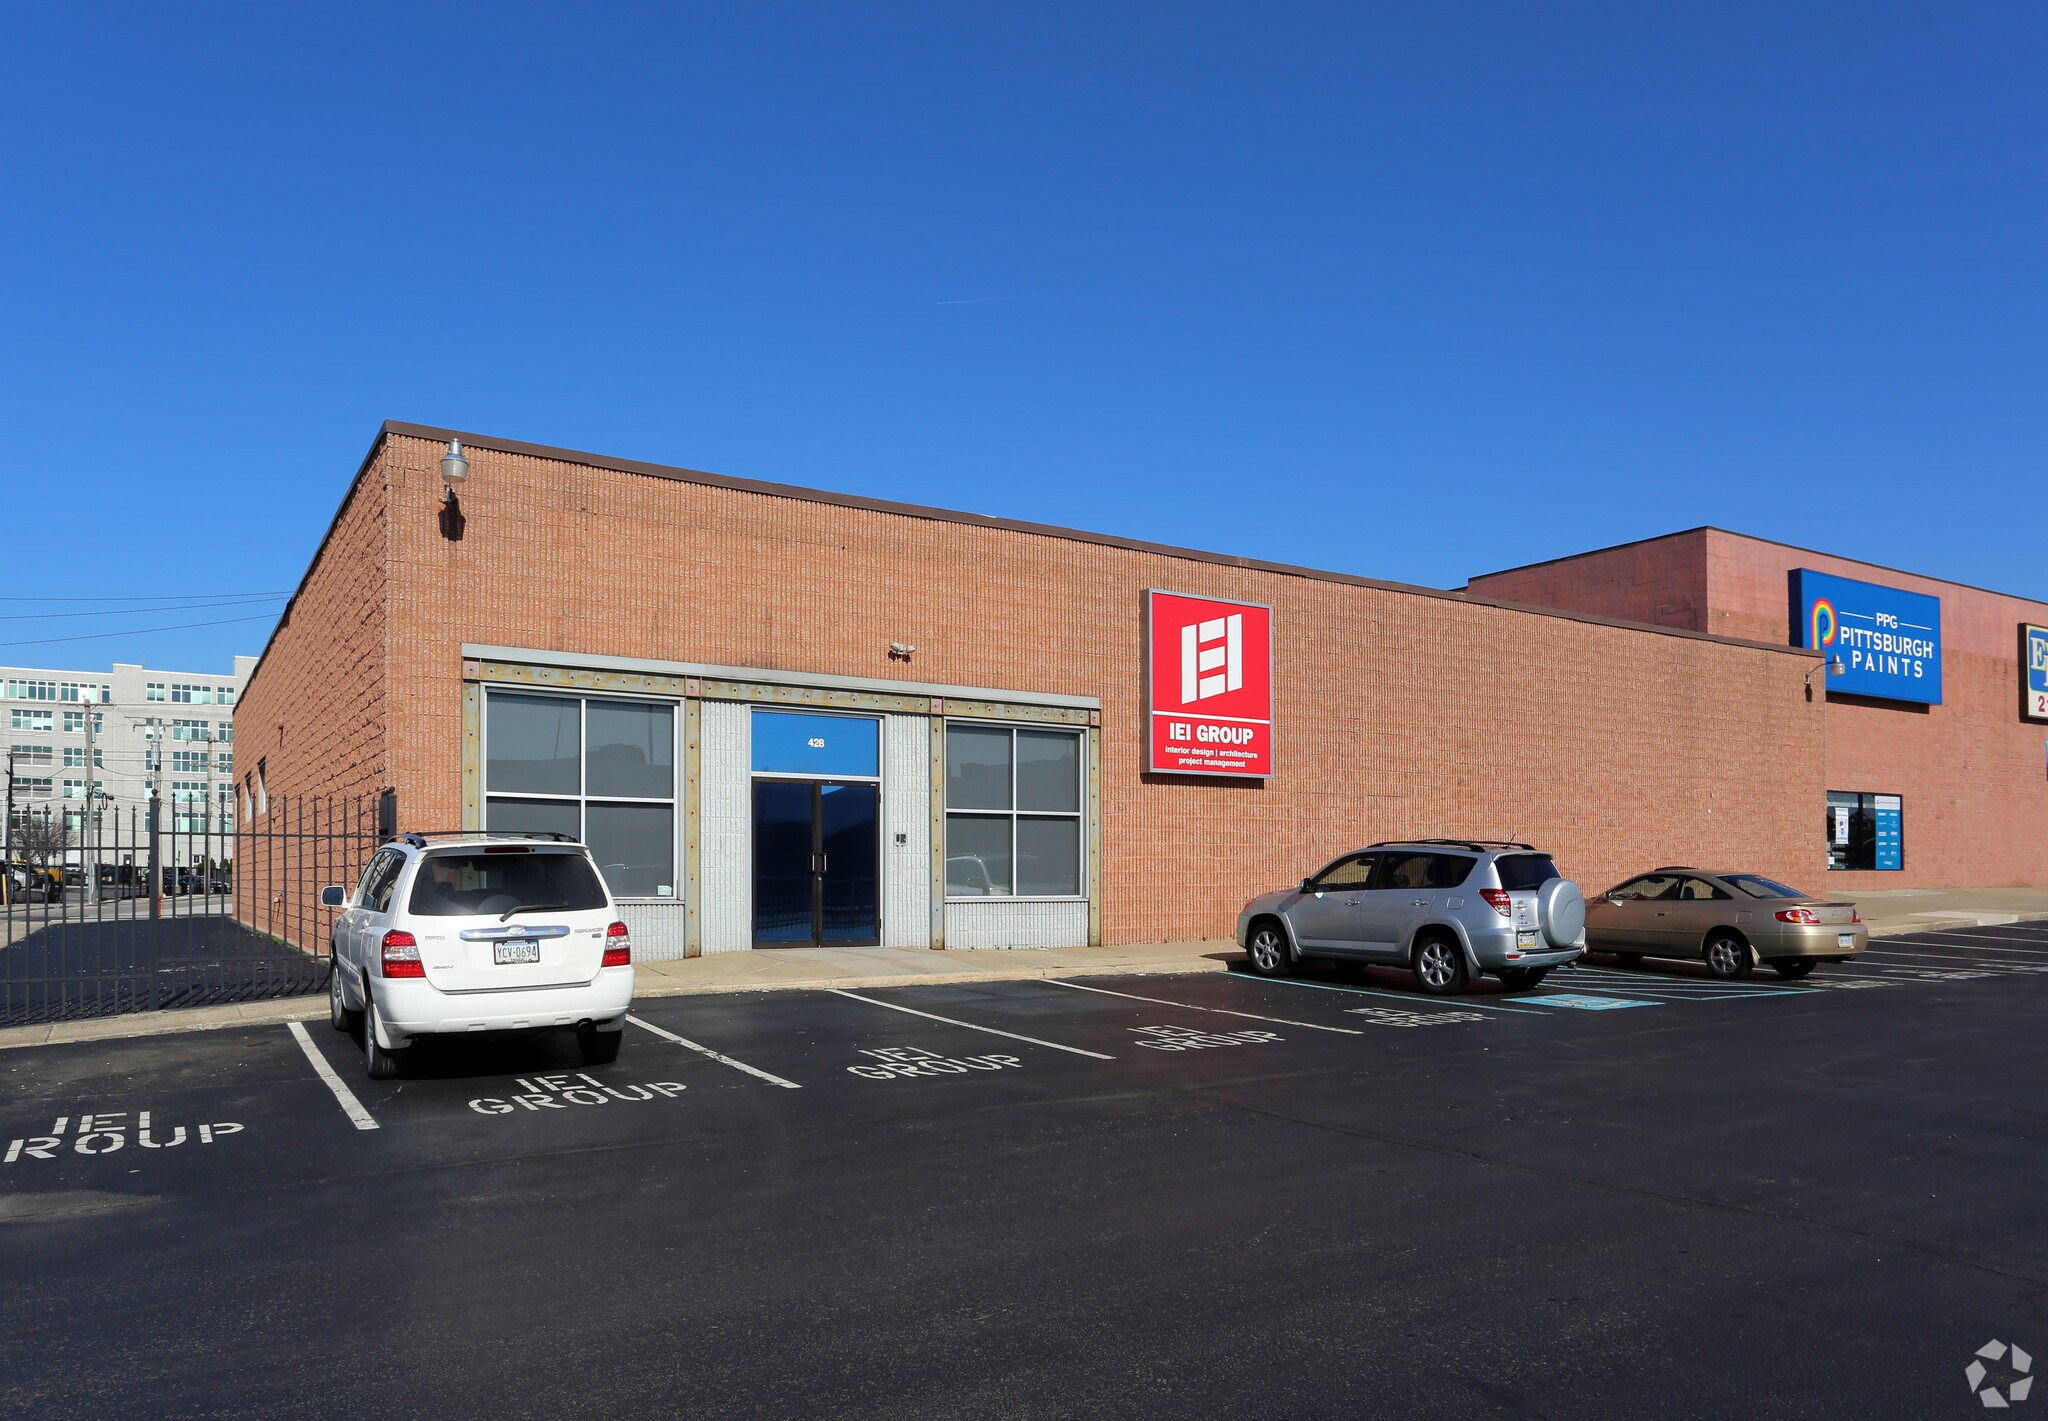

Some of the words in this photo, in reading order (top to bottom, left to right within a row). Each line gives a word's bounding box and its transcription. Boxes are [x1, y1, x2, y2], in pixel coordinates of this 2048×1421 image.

[1876, 612, 1898, 629] PPG
[1840, 626, 1933, 659] PITTSBURGH
[1852, 649, 1923, 679] PAINTS
[808, 737, 825, 748] 428
[1169, 722, 1191, 741] IEI
[1196, 724, 1254, 745] GROUP
[1165, 745, 1190, 754] interior
[1191, 747, 1214, 757] design
[1219, 749, 1258, 759] architecture
[1178, 757, 1203, 766] project
[1203, 758, 1246, 768] management
[857, 1046, 944, 1063] IEI
[847, 1054, 1023, 1080] GROUP
[515, 1073, 605, 1093] IEI
[468, 1082, 687, 1115] GROUP
[52, 1111, 151, 1135] IEI
